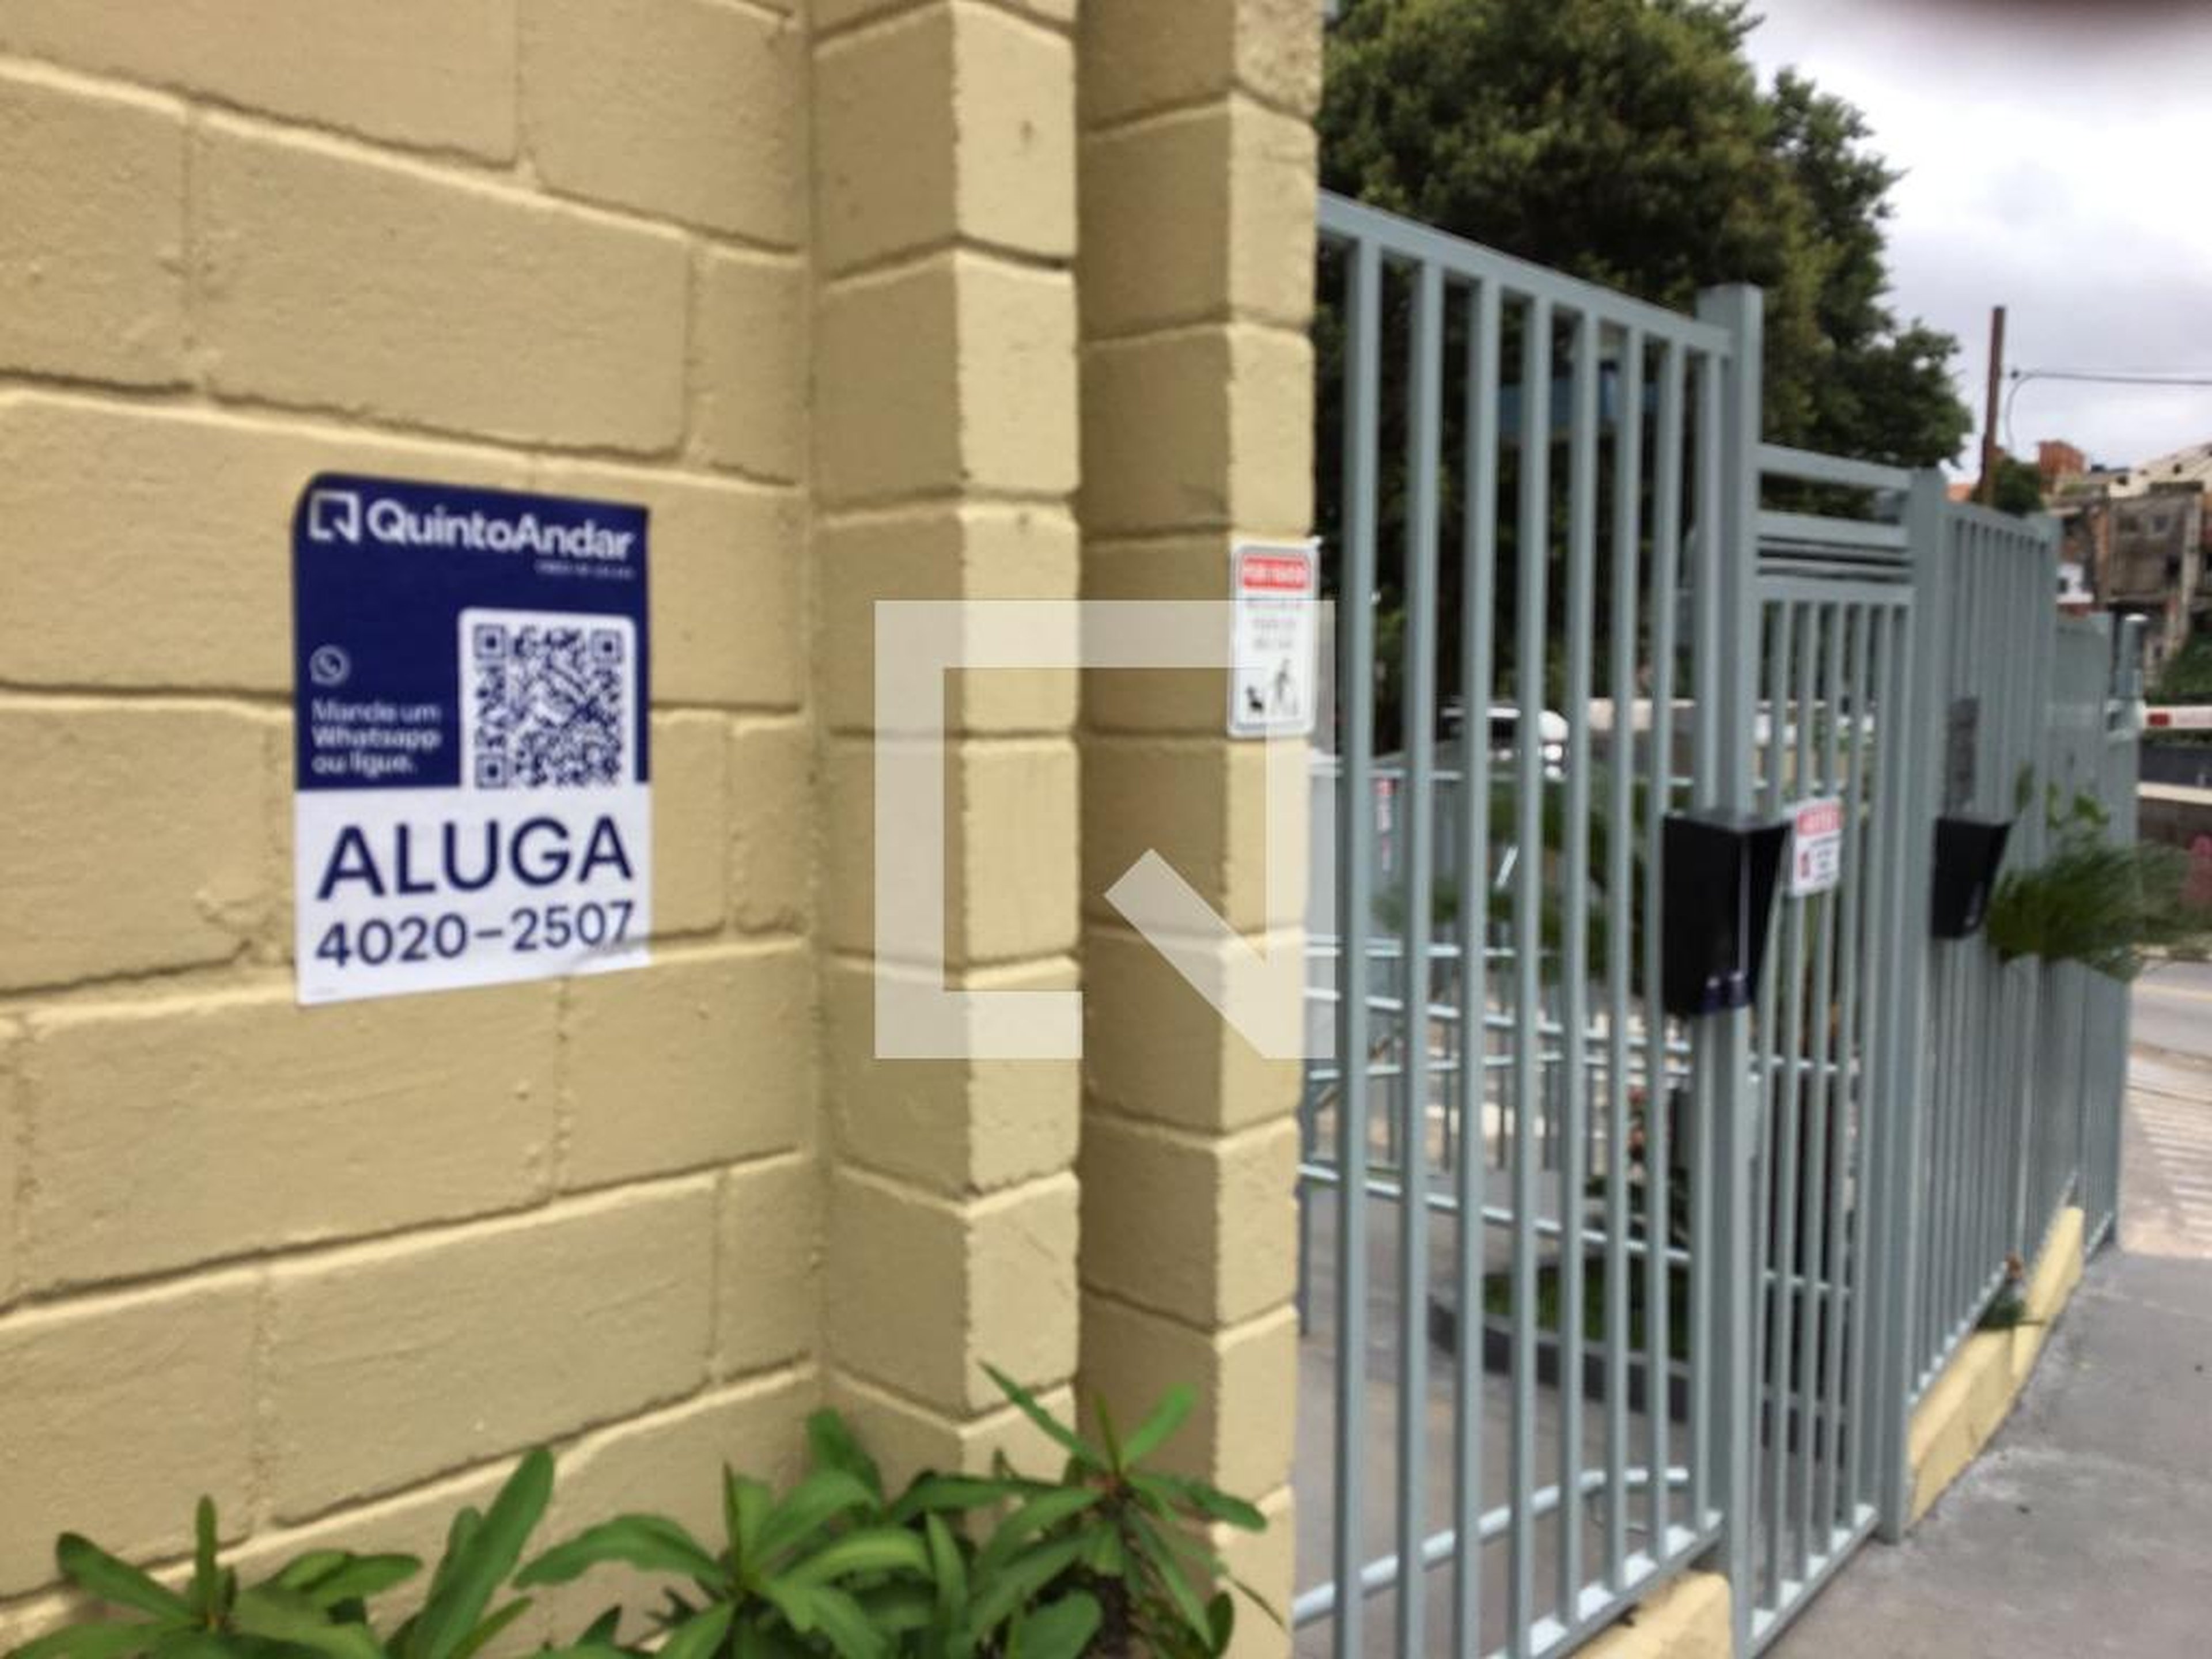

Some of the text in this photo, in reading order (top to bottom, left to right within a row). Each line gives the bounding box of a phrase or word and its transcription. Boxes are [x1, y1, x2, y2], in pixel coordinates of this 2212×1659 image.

[366, 498, 634, 560] QuintoAndar
[312, 699, 398, 722] Mande
[312, 756, 347, 773] ou
[316, 815, 634, 901] ALUGA
[315, 900, 635, 967] 4020-2507
